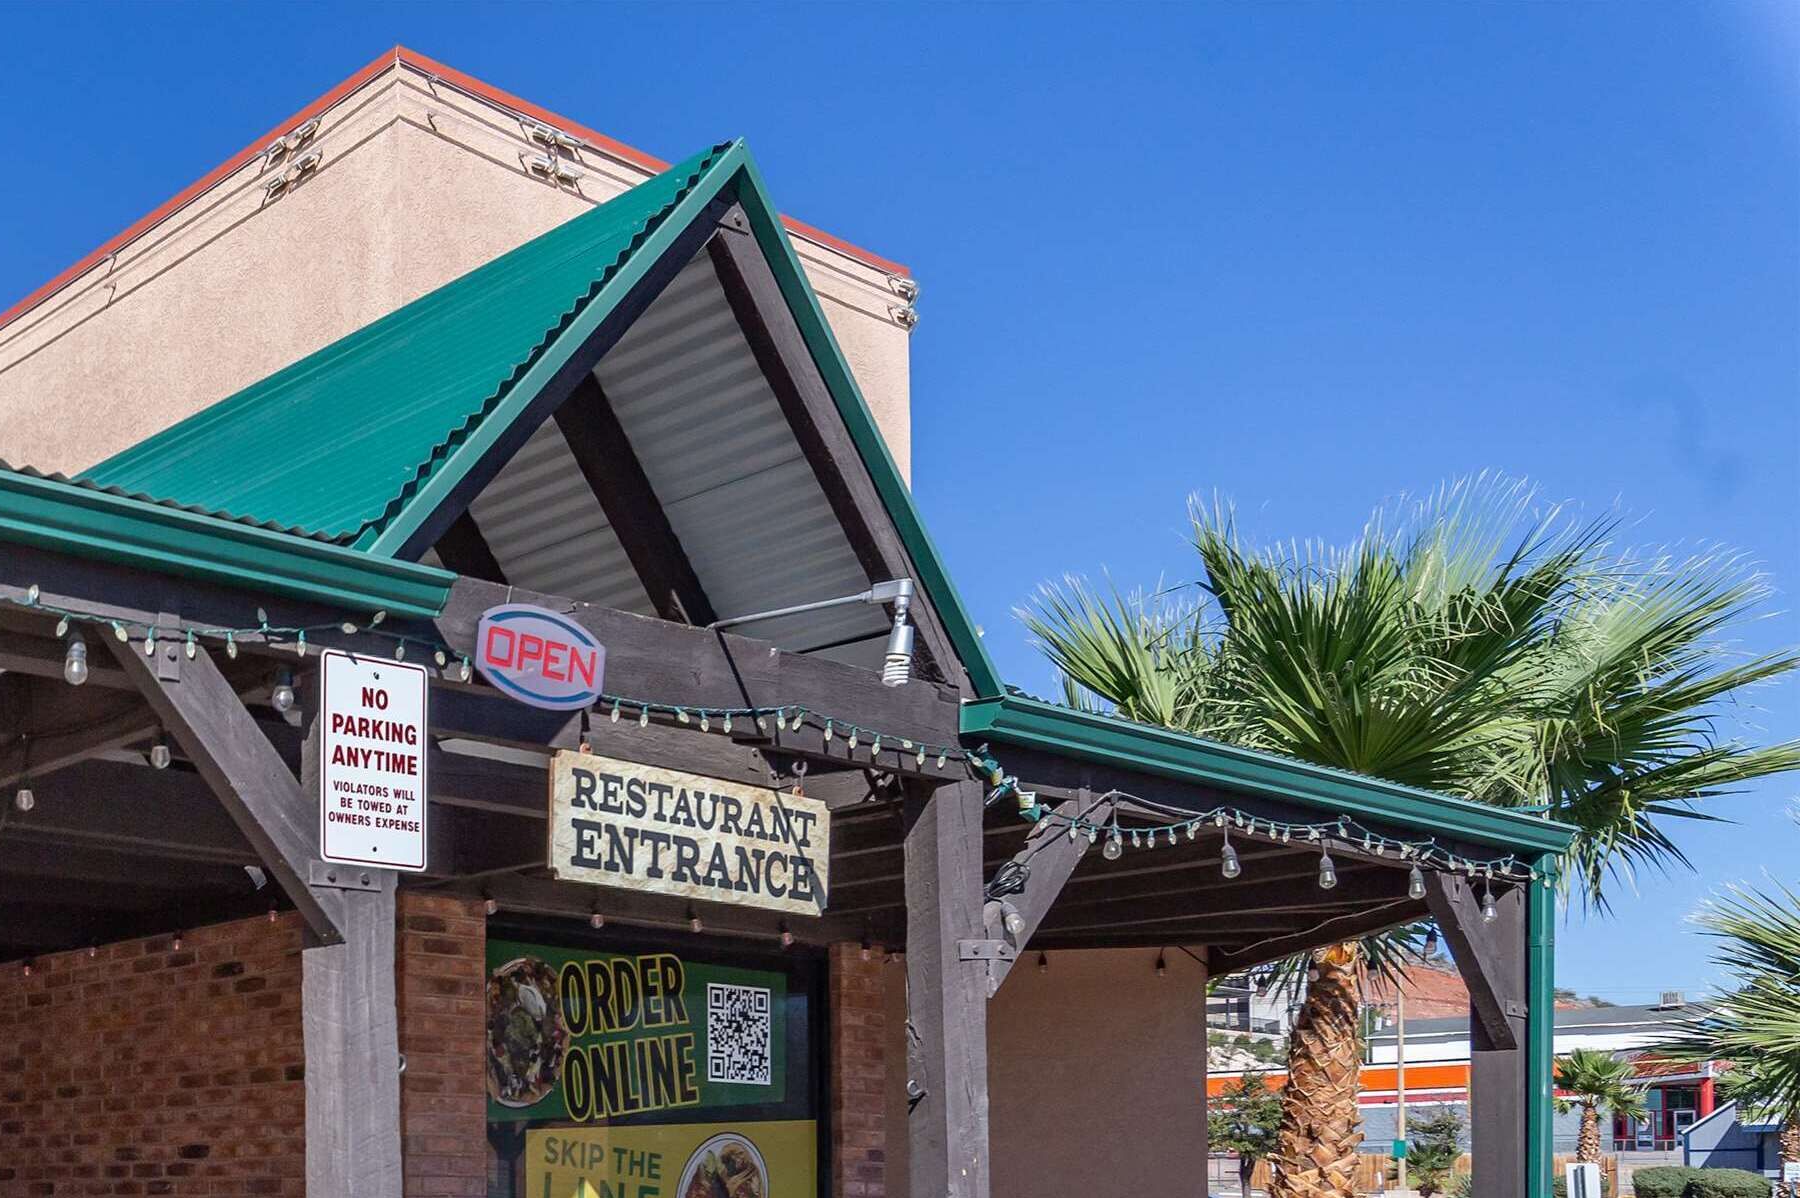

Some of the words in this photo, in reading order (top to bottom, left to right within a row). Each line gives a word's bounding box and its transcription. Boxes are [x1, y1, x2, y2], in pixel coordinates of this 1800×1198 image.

[485, 625, 598, 687] OPEN
[361, 687, 388, 710] NO
[332, 713, 417, 745] PARKING
[332, 745, 418, 776] ANYTIME
[333, 780, 389, 797] VIOLATORS
[393, 789, 416, 801] WILL
[340, 797, 353, 809] BE
[358, 799, 392, 813] TOWED
[396, 804, 408, 815] AT
[570, 767, 817, 848] RESTAURANT
[328, 811, 371, 826] OWNERS
[375, 817, 420, 833] EXPENSE
[570, 817, 815, 902] ENTRANCE
[559, 953, 689, 1036] ORDER
[562, 1032, 700, 1123] ONLINE
[544, 1135, 605, 1166] SKIP
[613, 1146, 663, 1180] THE
